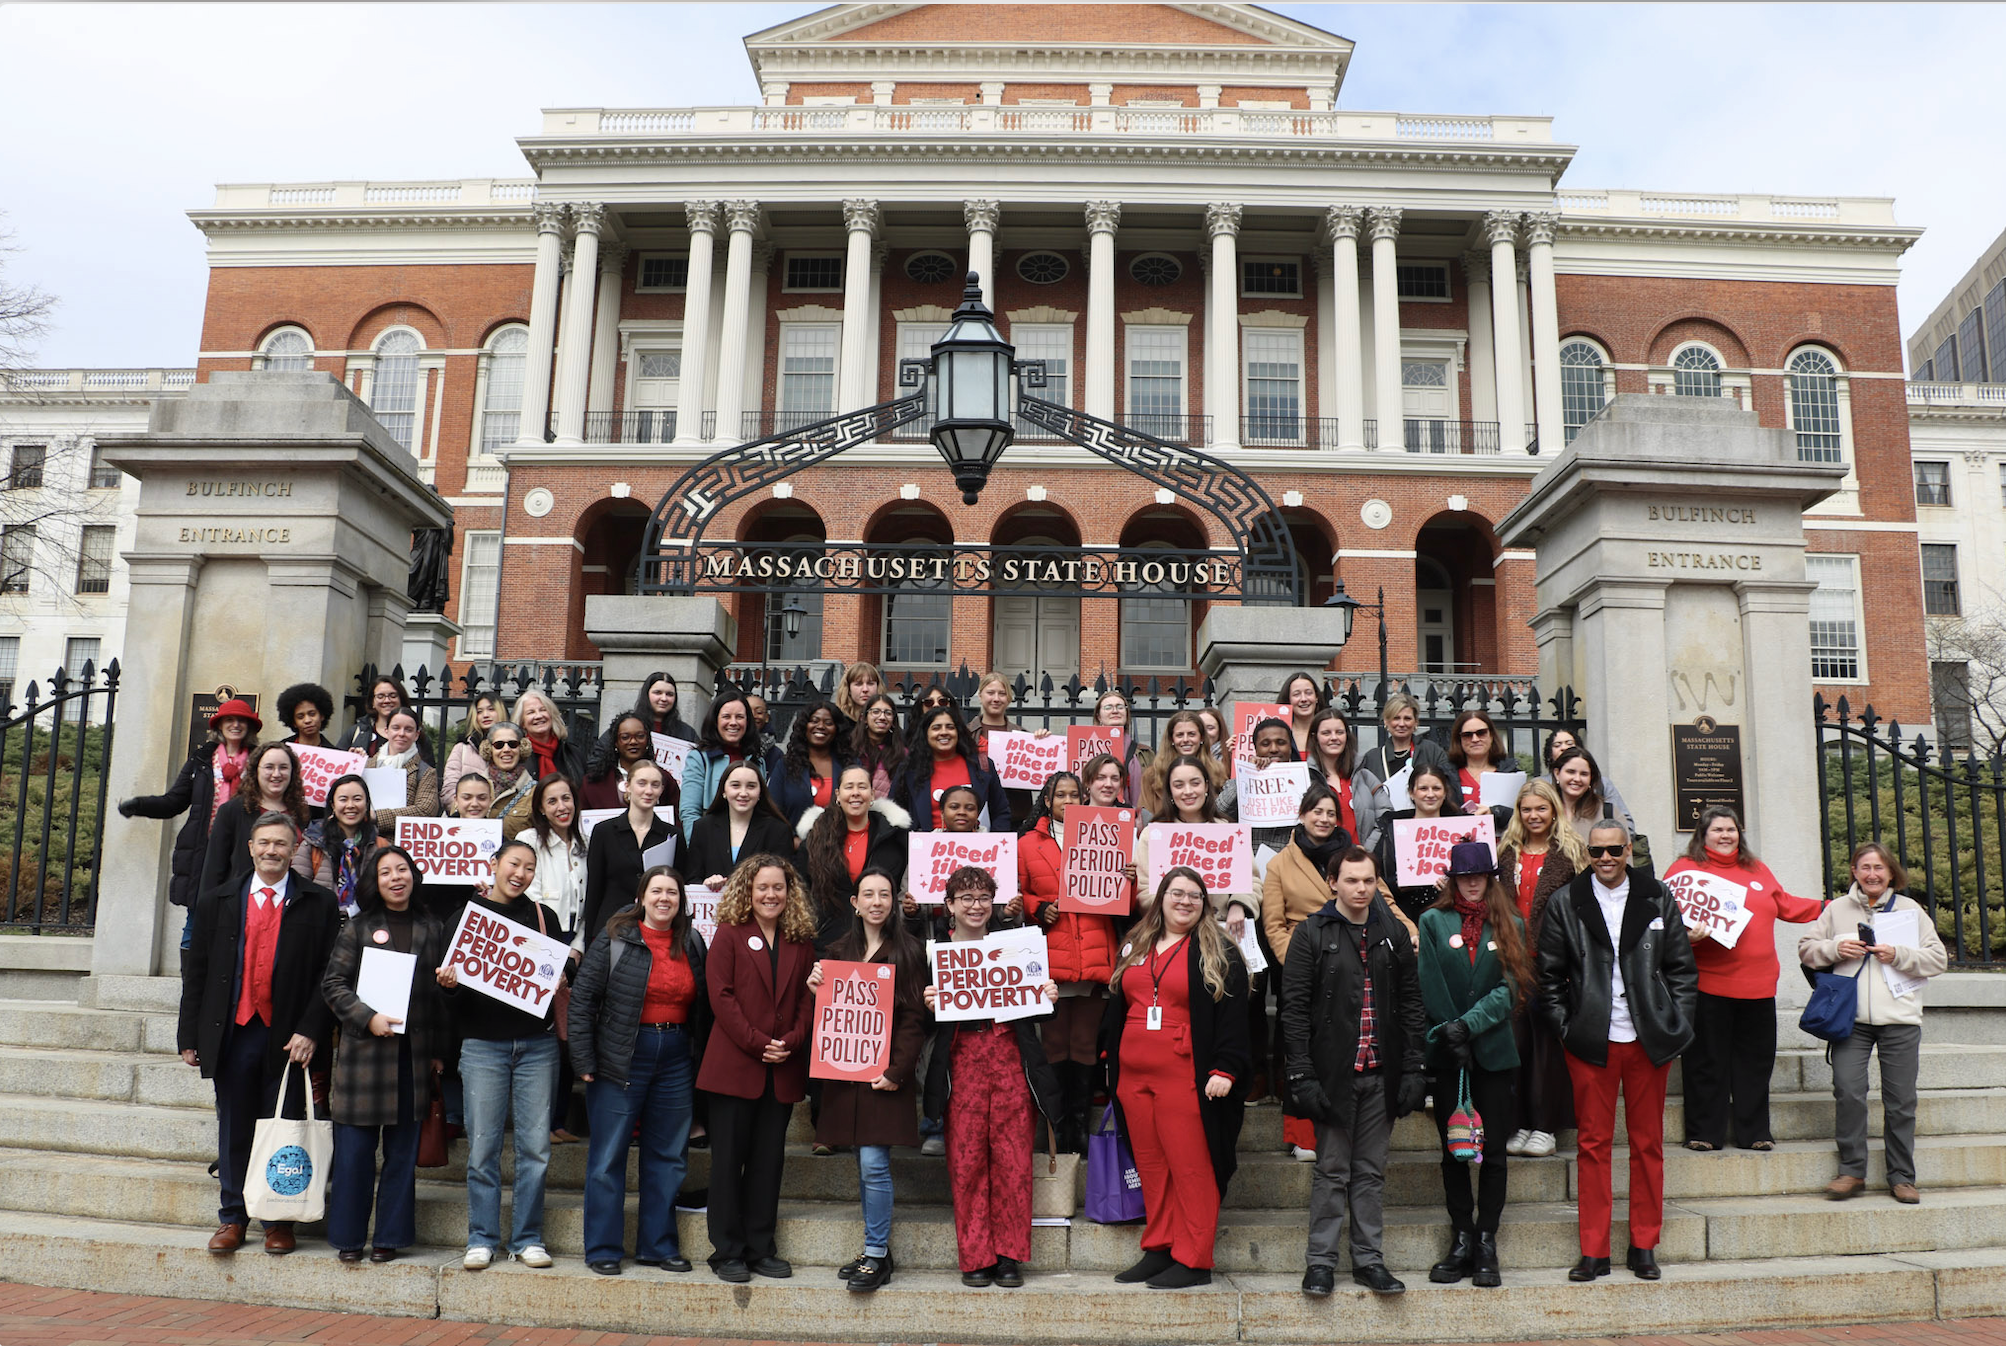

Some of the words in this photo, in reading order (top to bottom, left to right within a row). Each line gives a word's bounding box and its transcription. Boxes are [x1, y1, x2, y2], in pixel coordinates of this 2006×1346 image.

[186, 482, 293, 497] BULFINCH
[1648, 505, 1757, 524] BULFINCH
[178, 527, 291, 543] ENTRANCE
[705, 555, 990, 581] MASSACHUSETTS
[1003, 559, 1102, 583] STATE
[1115, 561, 1231, 586] HOUSE
[1648, 552, 1762, 571] ENTRANCE
[1006, 739, 1059, 758] bleed
[1079, 740, 1112, 758] PASS
[1006, 752, 1043, 771] like
[1044, 761, 1058, 771] a
[299, 766, 328, 788] ike
[1248, 777, 1288, 795] FREE
[1242, 805, 1268, 817] TOILET
[1271, 805, 1300, 816] PAPE
[1247, 797, 1268, 808] JUST
[1270, 796, 1294, 807] LIKE
[401, 823, 443, 840] END
[1079, 822, 1119, 846] PASS
[1170, 832, 1234, 853] bleed
[1415, 826, 1478, 845] bleed
[400, 841, 478, 858] PERIOD
[931, 841, 999, 863] bleed
[1069, 848, 1125, 873] PERIOD
[1170, 848, 1215, 870] like
[1217, 857, 1233, 870] a
[414, 858, 494, 876] OVERTY
[1068, 874, 1124, 899] POLICY
[1668, 875, 1693, 888] ND
[1674, 888, 1721, 912] RIOD
[464, 910, 510, 944] END
[1677, 900, 1738, 933] VERTY
[456, 929, 536, 978] PERIOD
[936, 948, 984, 970] END
[448, 949, 551, 1006] POVERTY
[937, 966, 1023, 991] PERIOD
[833, 979, 879, 1006] PASS
[939, 985, 1045, 1011] POVERTY
[822, 1007, 884, 1035] PERIOD
[820, 1036, 882, 1065] POLICY
[277, 1163, 304, 1177] Egal
